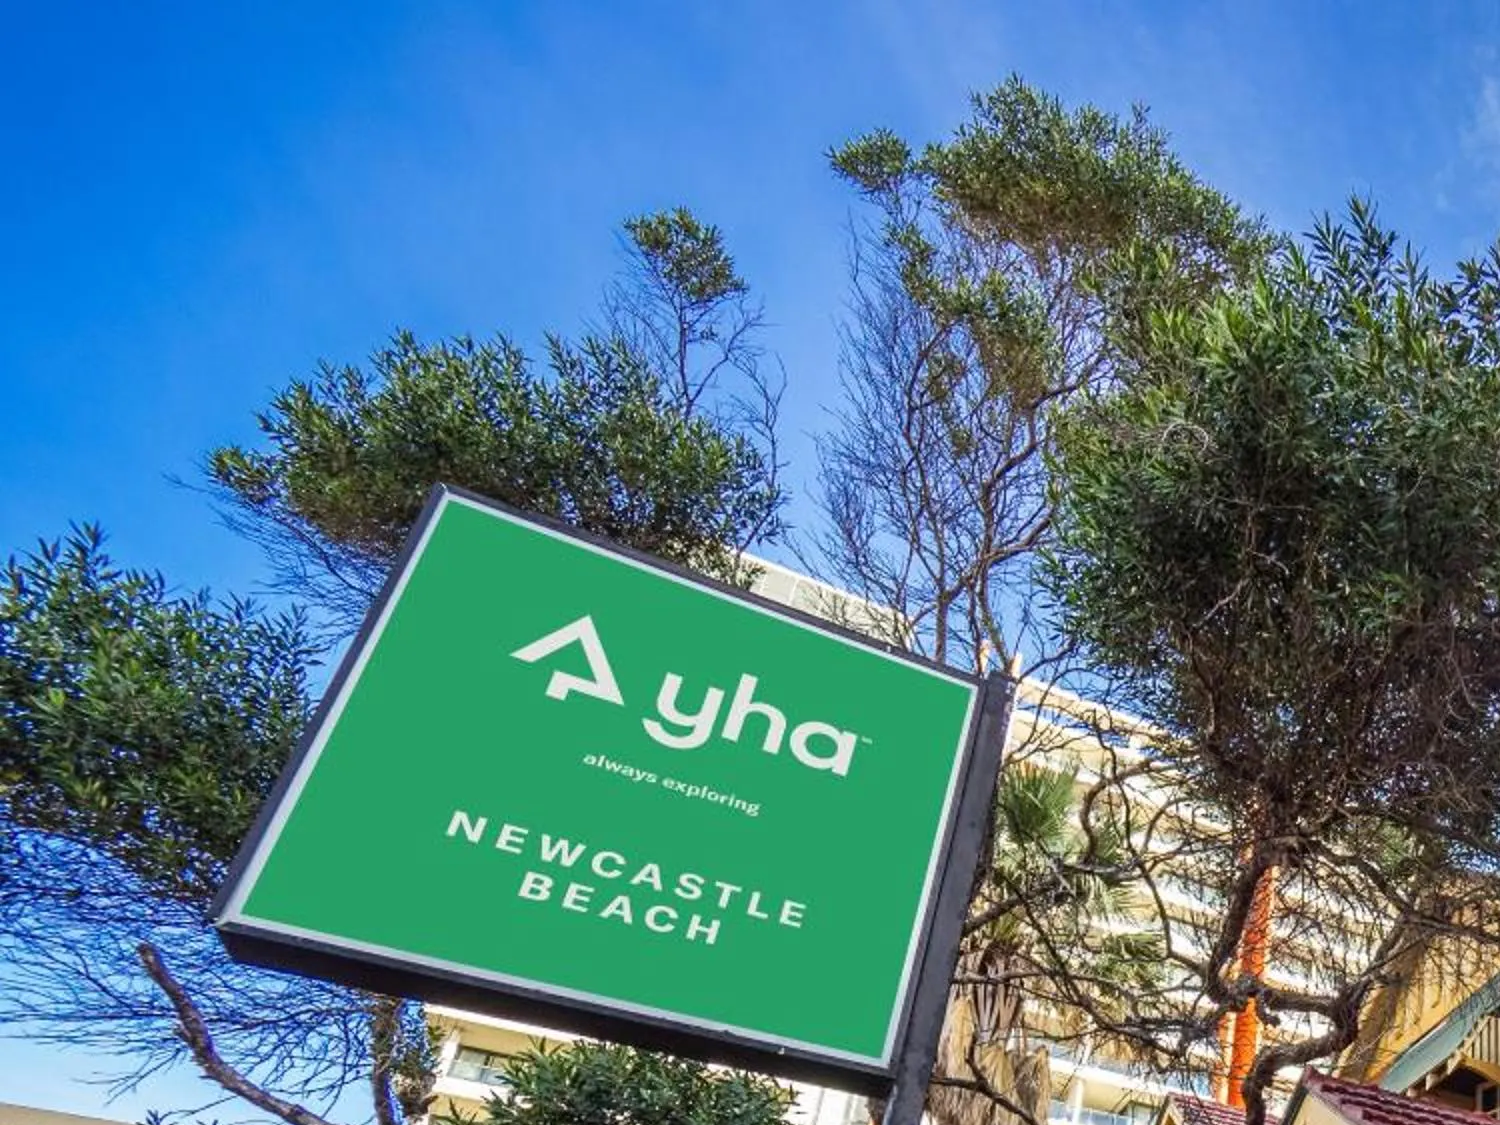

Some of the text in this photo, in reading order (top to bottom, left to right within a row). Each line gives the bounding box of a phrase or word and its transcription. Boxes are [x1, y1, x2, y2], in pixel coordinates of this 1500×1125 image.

[641, 671, 858, 777] yha
[582, 753, 762, 818] always exploring
[446, 810, 807, 929] NEWCASTLE
[517, 871, 722, 946] BEACH
